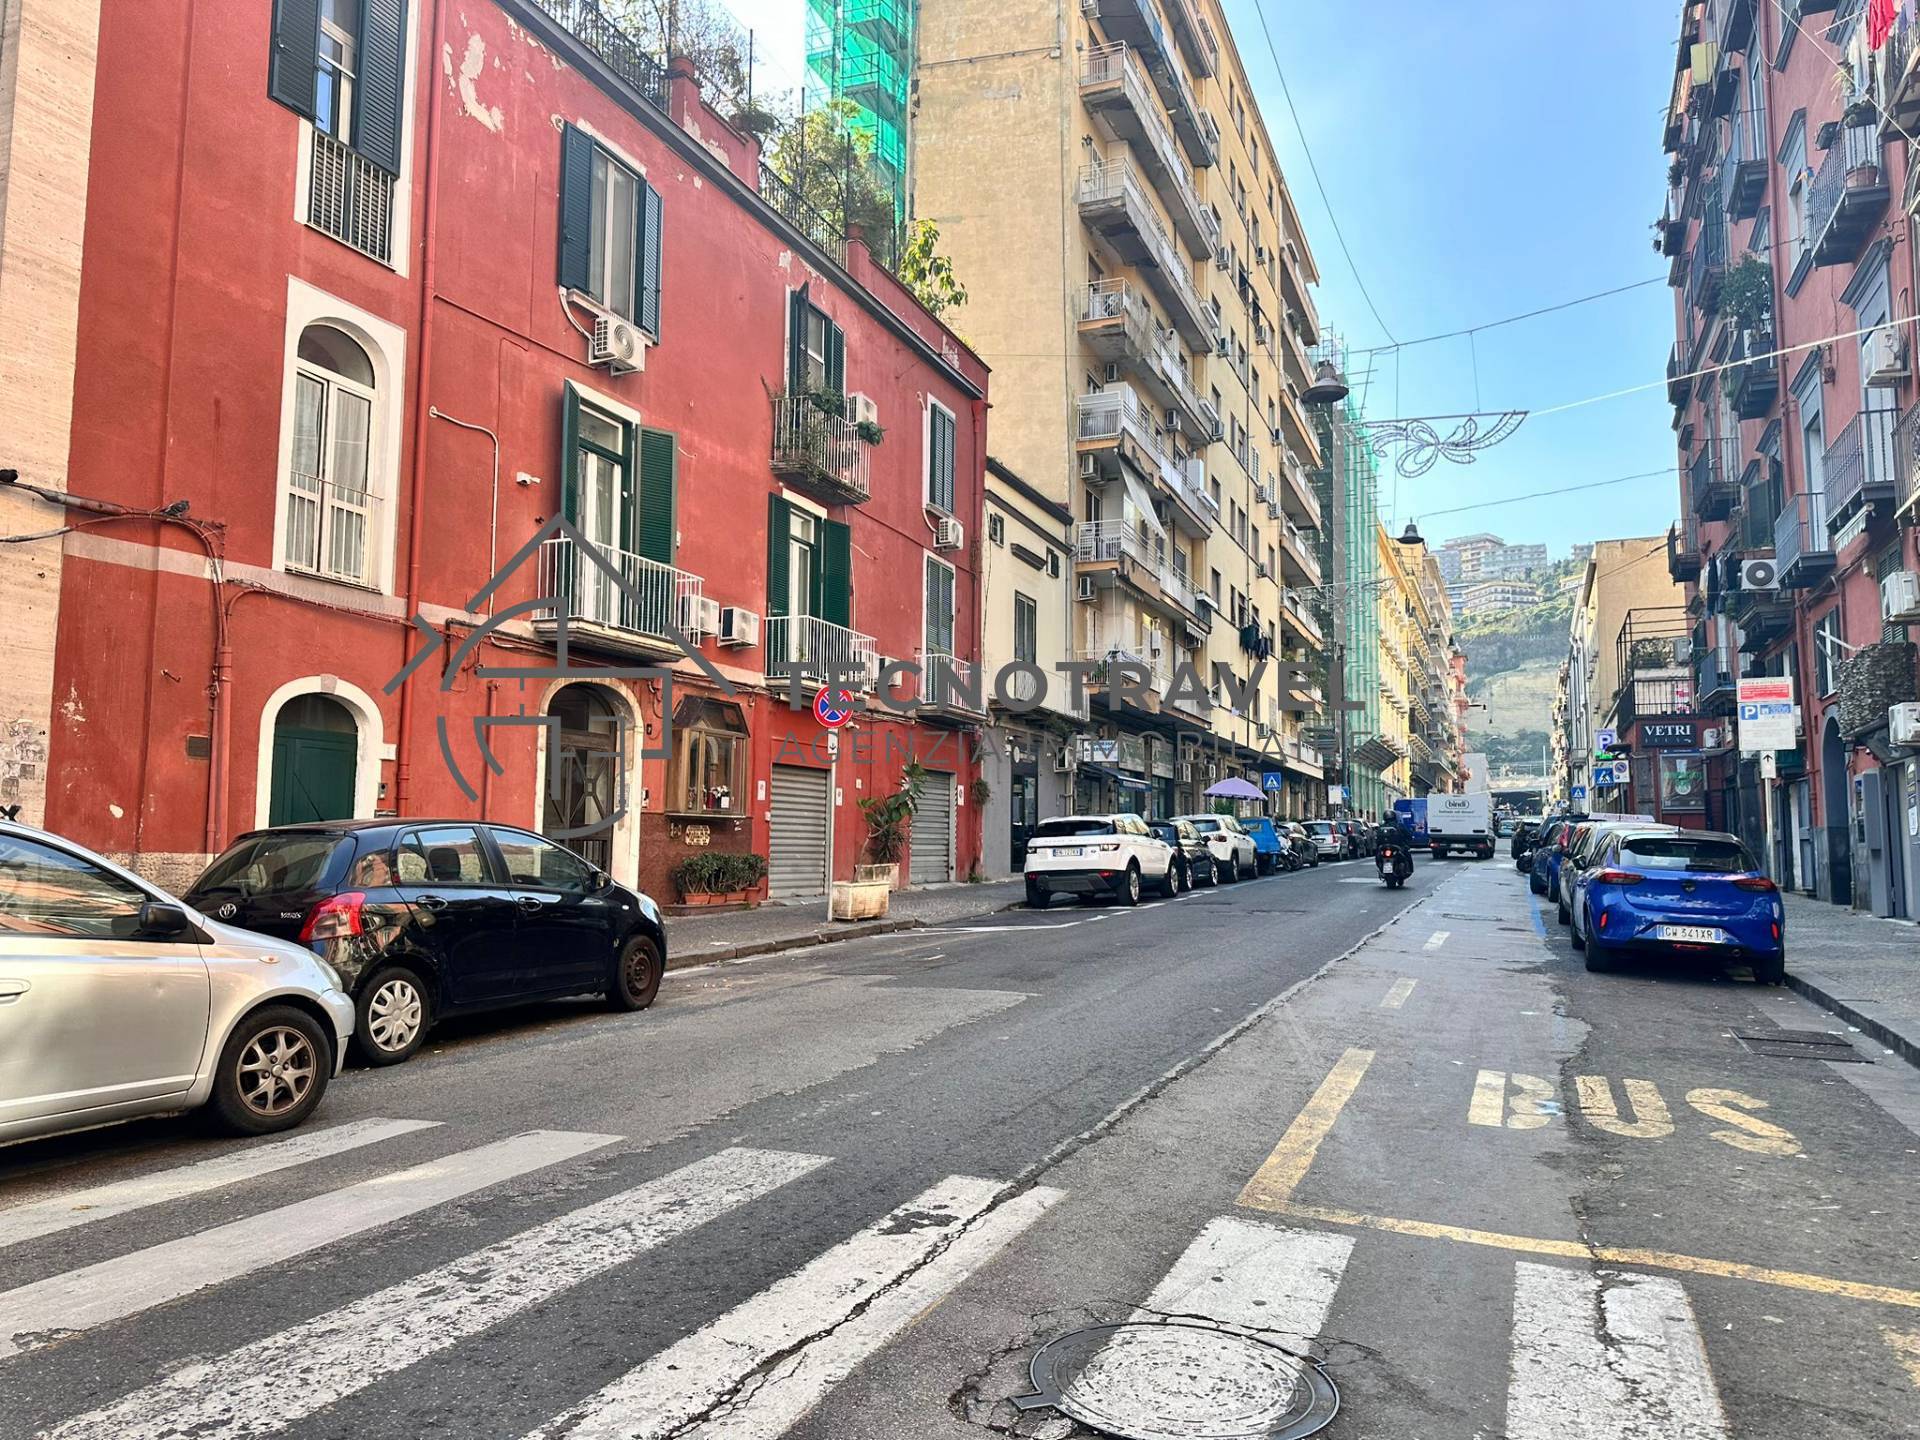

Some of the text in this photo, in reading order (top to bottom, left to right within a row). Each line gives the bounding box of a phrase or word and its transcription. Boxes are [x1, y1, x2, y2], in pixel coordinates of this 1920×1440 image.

[1744, 706, 1755, 719] P
[1644, 725, 1691, 736] VETRI
[1681, 928, 1713, 940] 341XR
[1467, 1069, 1803, 1155] BUS
